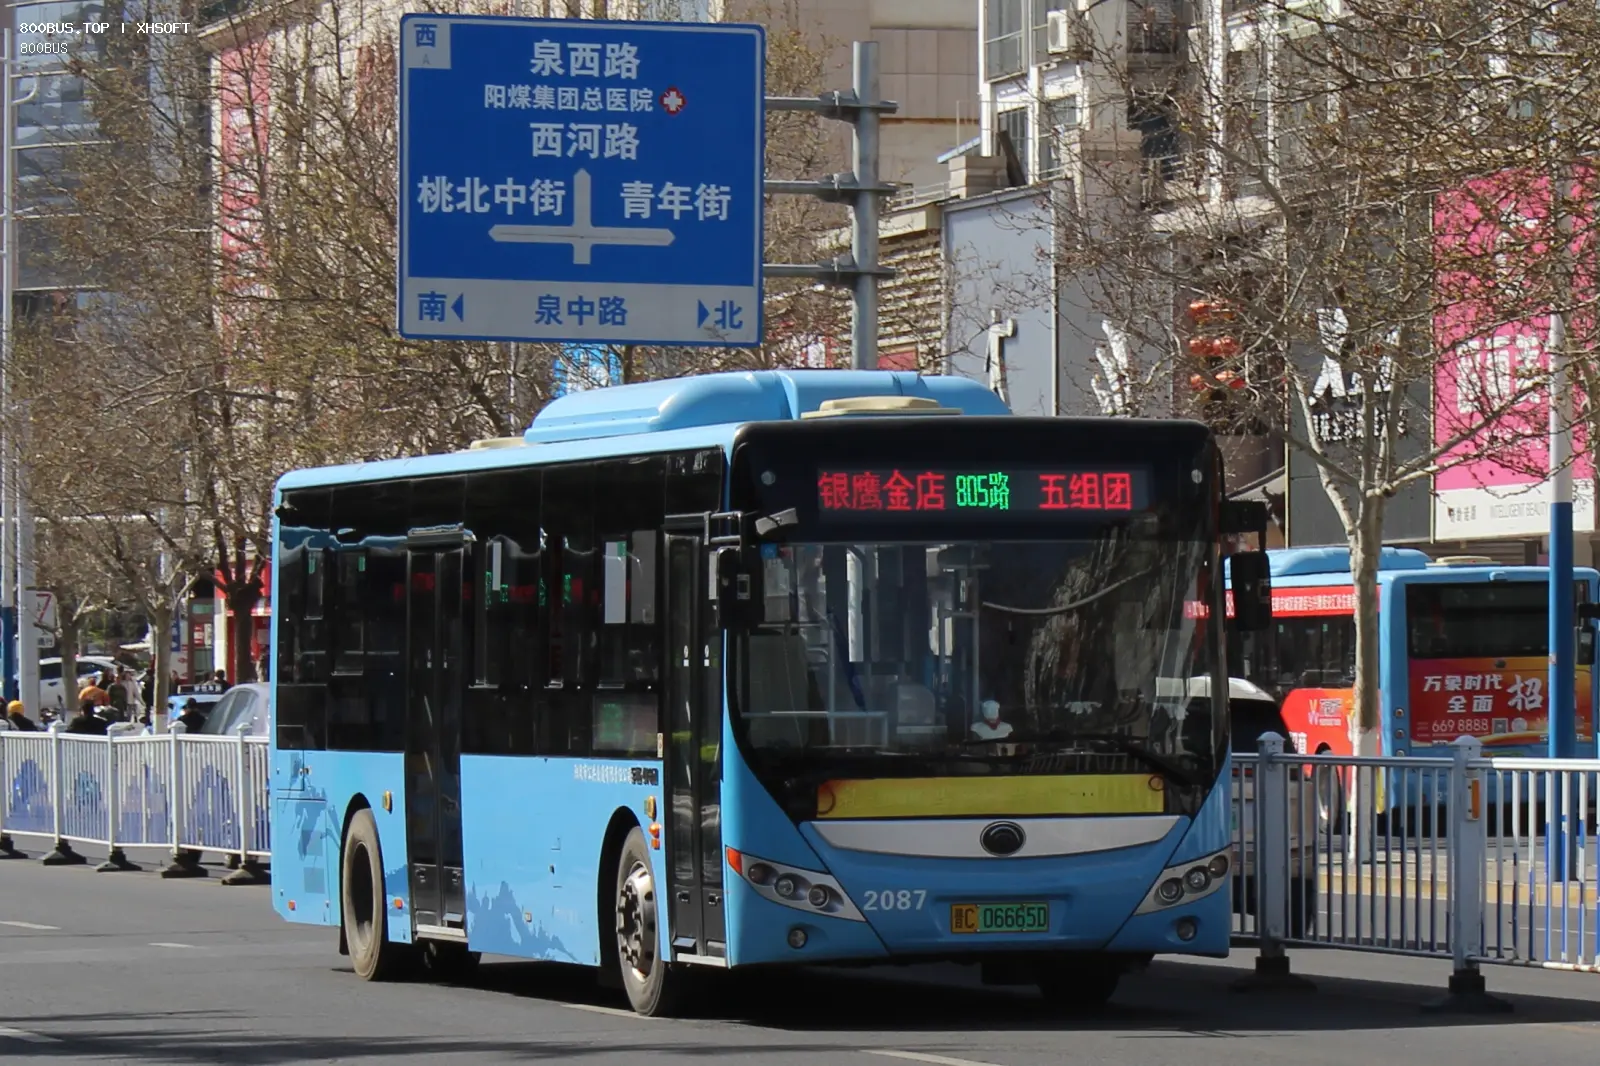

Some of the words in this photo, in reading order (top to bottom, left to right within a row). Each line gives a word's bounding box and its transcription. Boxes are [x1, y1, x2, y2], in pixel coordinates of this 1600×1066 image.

[414, 24, 438, 48] 西
[530, 39, 641, 80] 泉西路
[484, 84, 654, 113] 阳煤集团总医院
[530, 122, 641, 160] 西河路
[417, 175, 566, 217] 桃北中街
[620, 180, 732, 221] 青年街
[418, 291, 448, 323] 南
[534, 294, 628, 327] 泉中路
[714, 300, 744, 330] 北
[818, 469, 946, 511] 银鹰金店
[956, 472, 1010, 511] 805路
[1039, 472, 1133, 511] 五组团
[1423, 674, 1504, 692] 万象时代
[1447, 695, 1494, 713] 全面
[863, 889, 927, 912] 2087
